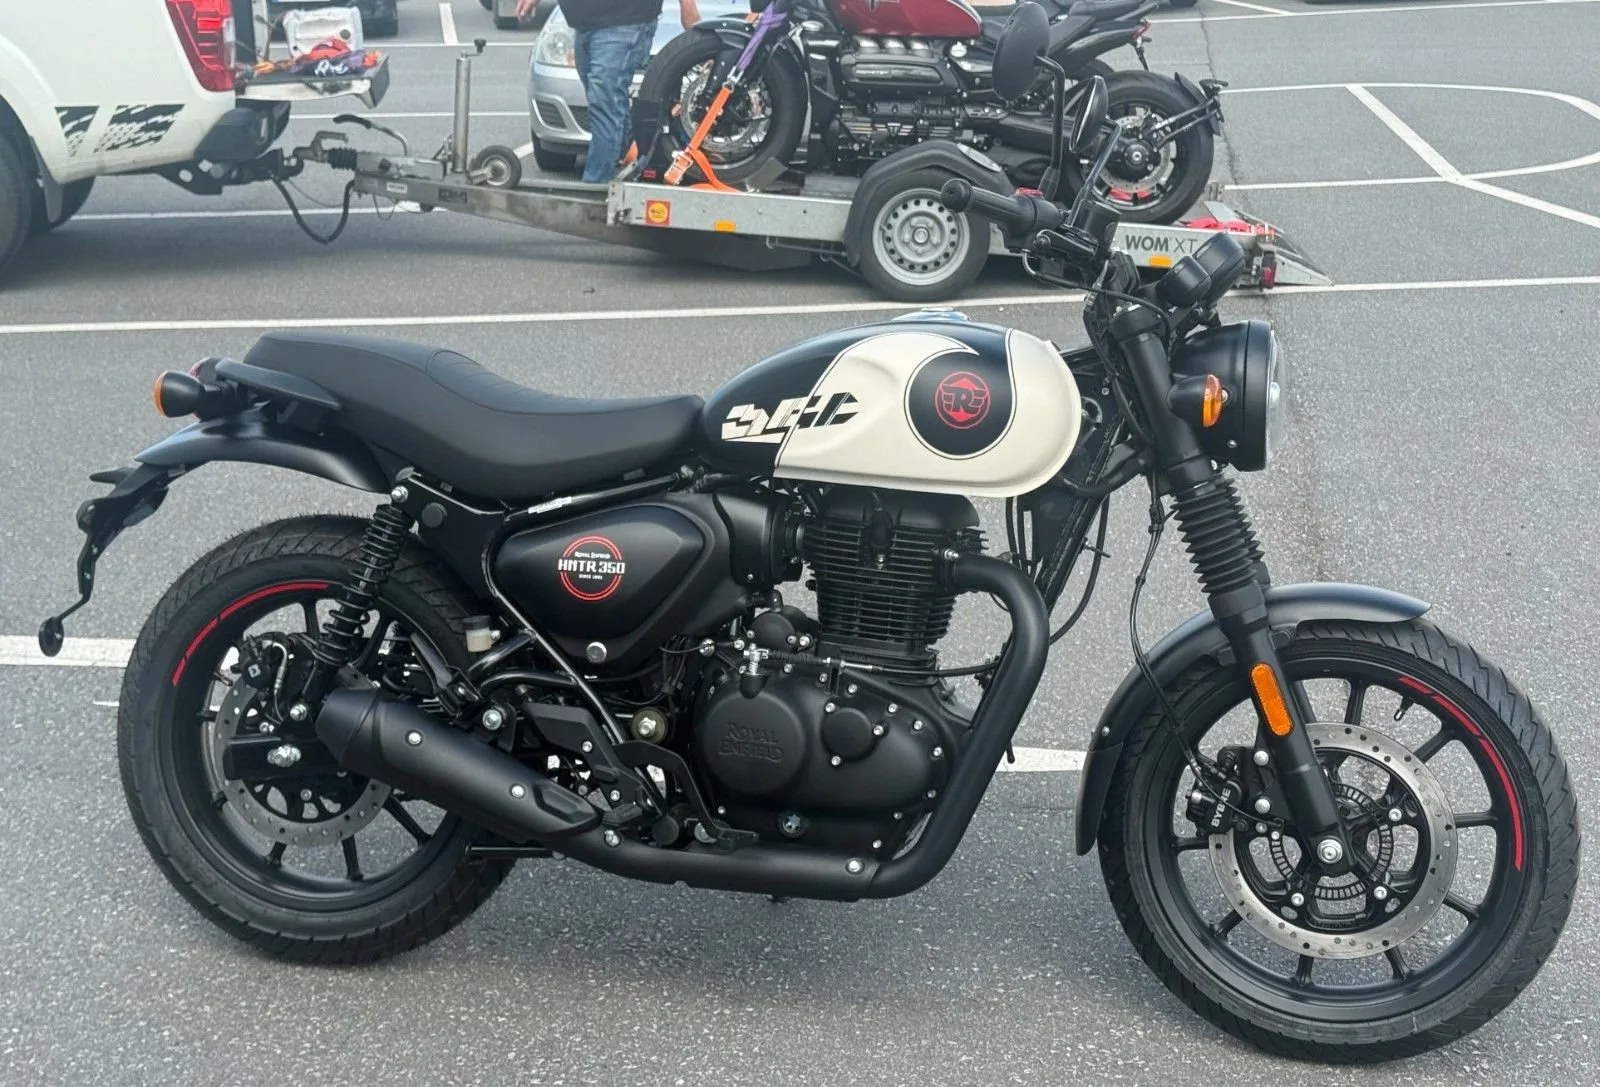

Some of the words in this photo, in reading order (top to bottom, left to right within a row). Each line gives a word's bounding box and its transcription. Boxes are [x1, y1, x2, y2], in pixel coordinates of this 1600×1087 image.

[1125, 235, 1169, 253] WOM
[1173, 238, 1198, 253] XT
[558, 559, 597, 573] HNTR
[598, 561, 626, 574] 350
